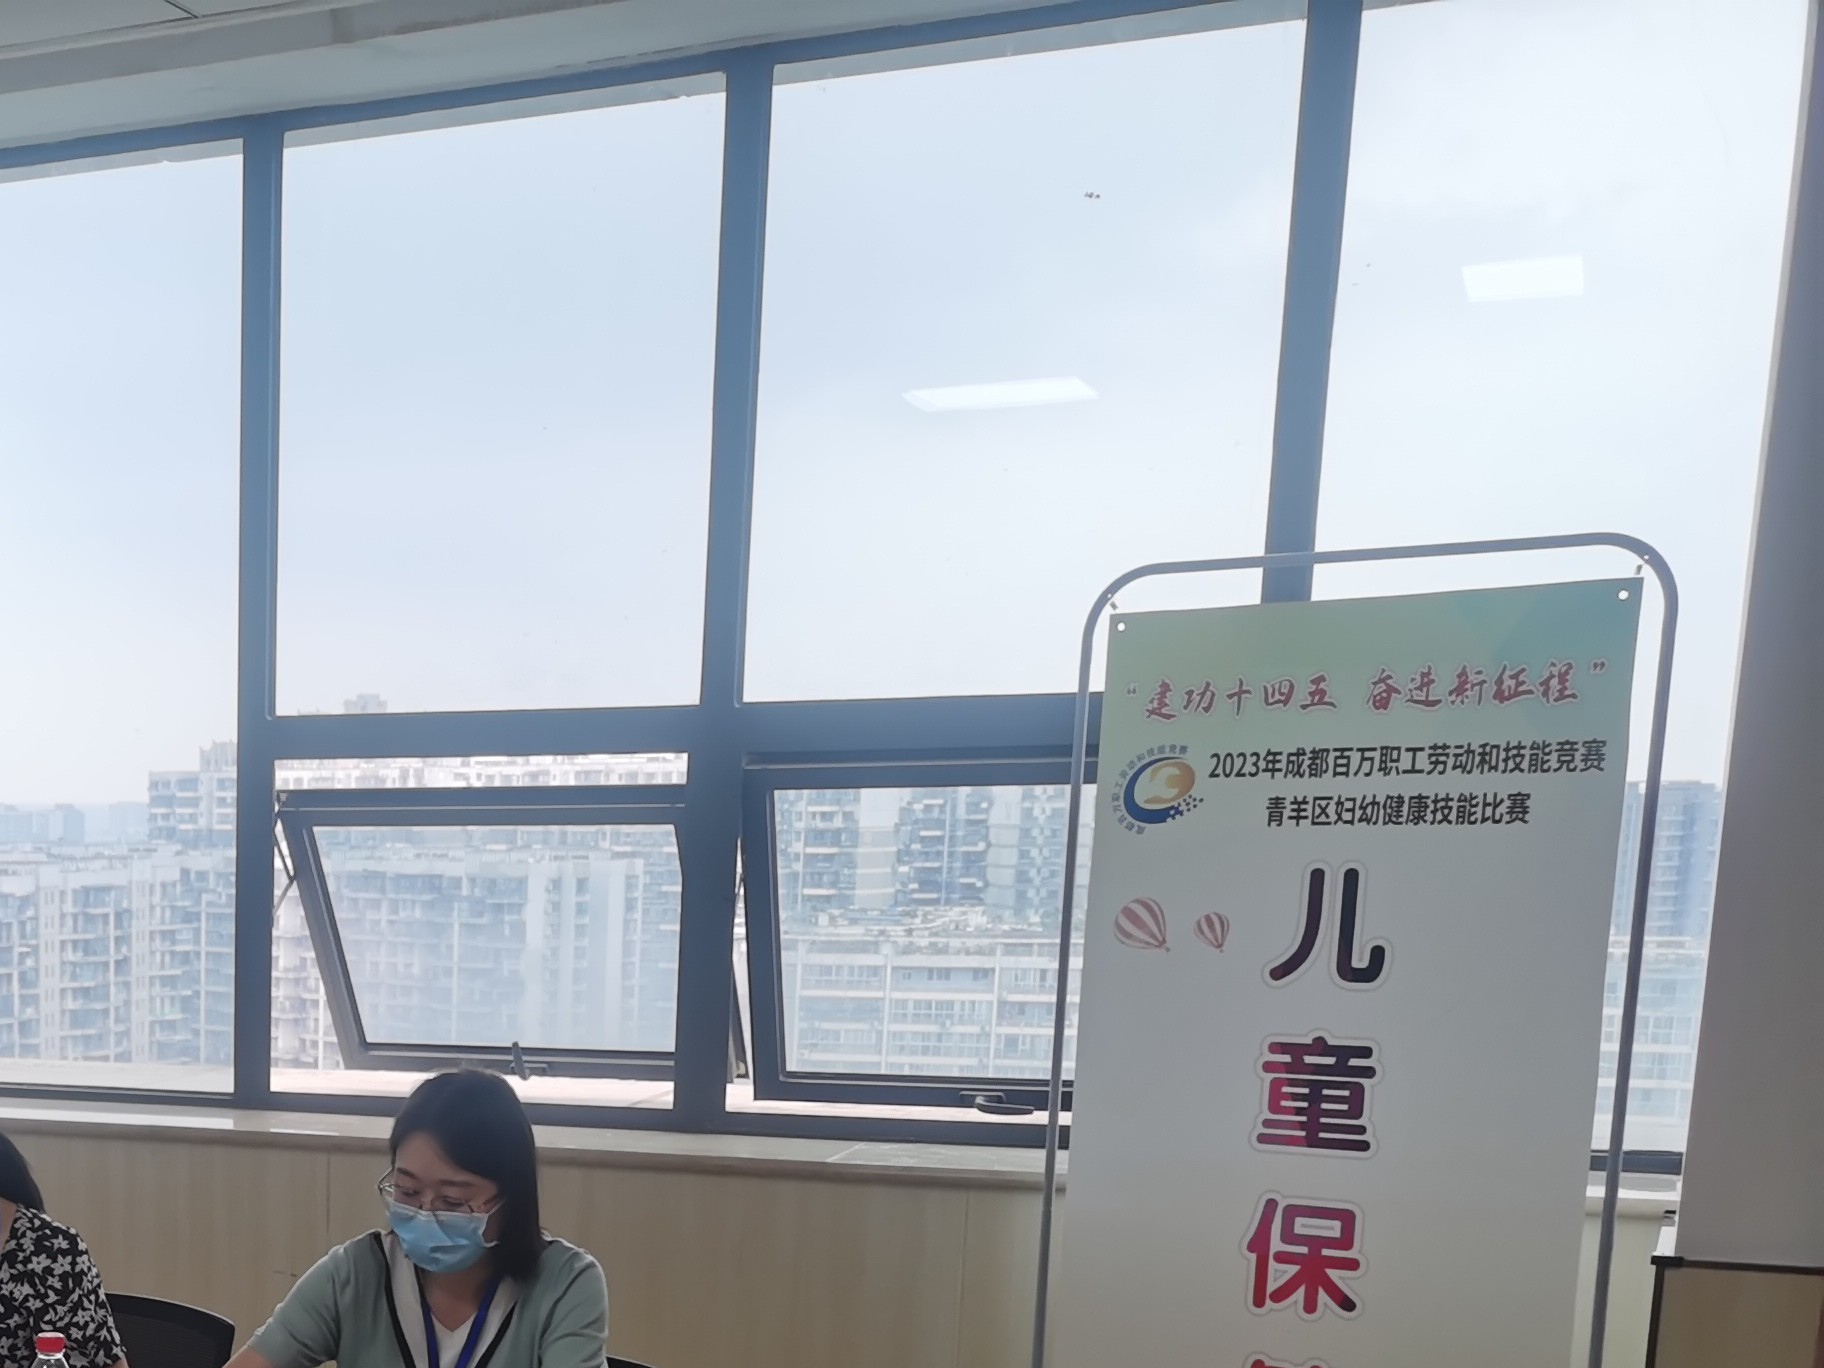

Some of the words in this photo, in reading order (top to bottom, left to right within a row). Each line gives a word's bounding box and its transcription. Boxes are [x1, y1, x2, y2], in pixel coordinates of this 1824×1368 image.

[1208, 737, 1608, 780] 2023年成都百万职工劳动和技能竞赛
[1265, 791, 1531, 828] 青羊区妇幼健康技能比赛
